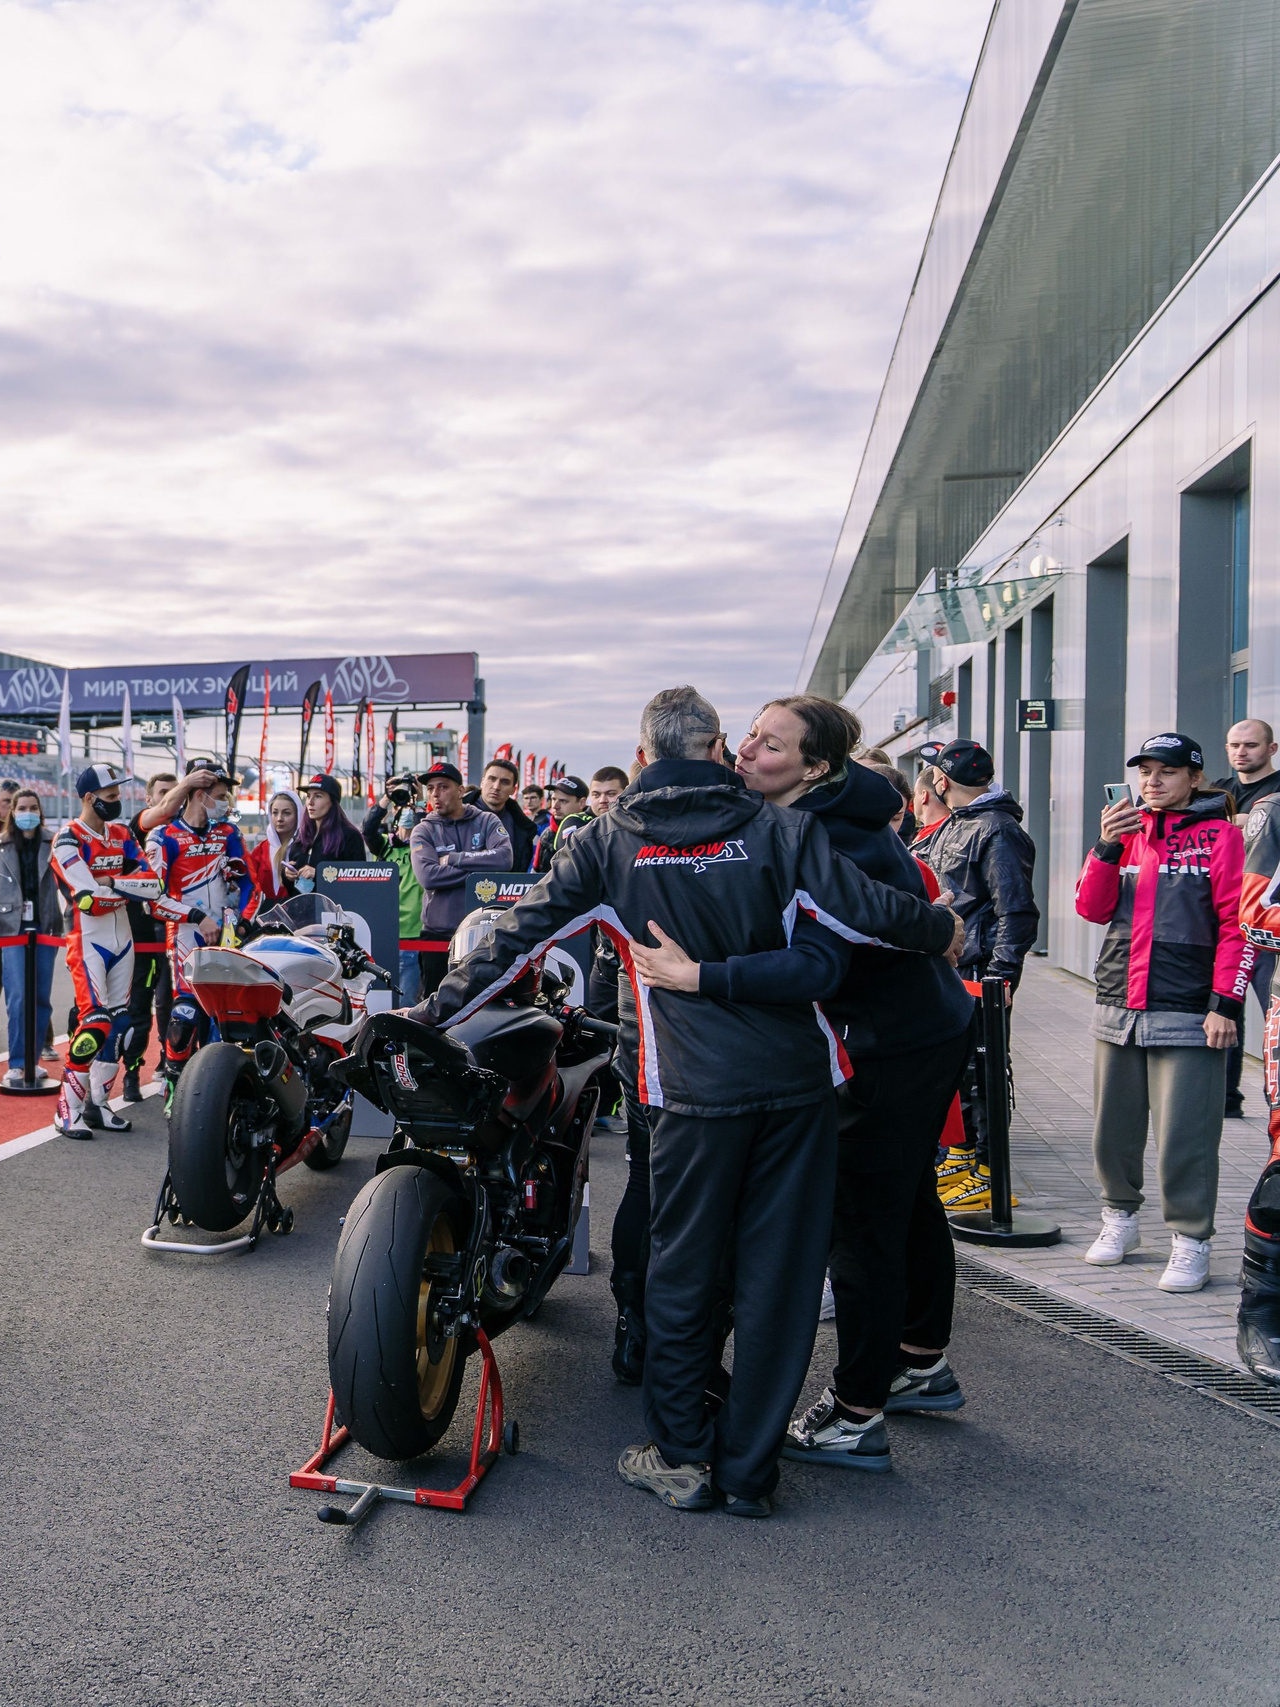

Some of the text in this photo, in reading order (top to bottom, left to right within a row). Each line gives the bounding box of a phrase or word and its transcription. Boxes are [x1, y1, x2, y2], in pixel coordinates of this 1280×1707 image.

[84, 670, 299, 697] МИР ТВОИХ ЭМЦИЙ
[188, 843, 224, 854] SPB
[636, 841, 726, 859] MOSCOW
[92, 855, 124, 867] SPB
[634, 856, 694, 867] RACEWAY
[337, 867, 394, 878] MOTORING
[1232, 969, 1248, 997] DRY
